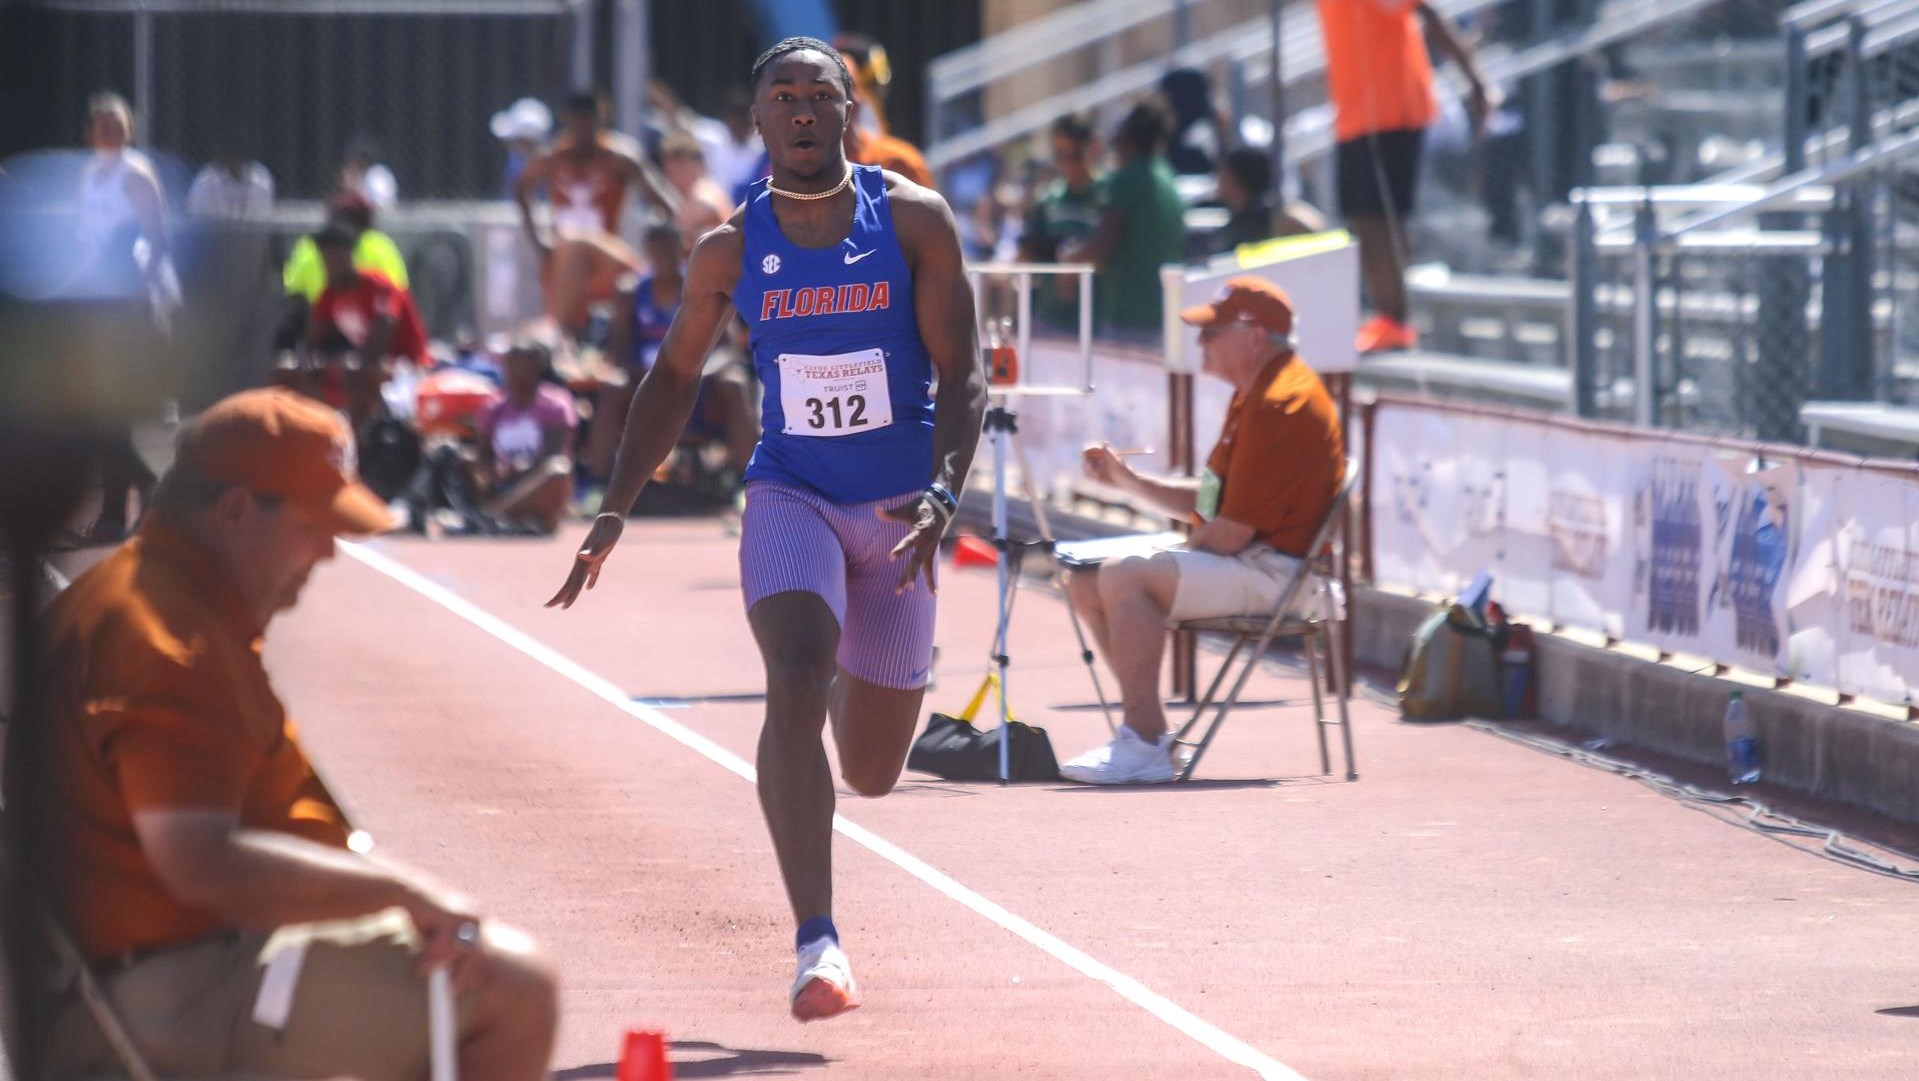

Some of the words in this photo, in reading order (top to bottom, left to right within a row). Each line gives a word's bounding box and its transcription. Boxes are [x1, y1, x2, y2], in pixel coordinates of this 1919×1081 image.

[762, 254, 780, 274] SEC
[760, 281, 889, 321] FLORIDA
[805, 370, 840, 380] TEXAS
[842, 364, 883, 378] RELAYS
[824, 383, 853, 393] TRUIST
[805, 394, 868, 429] 312
